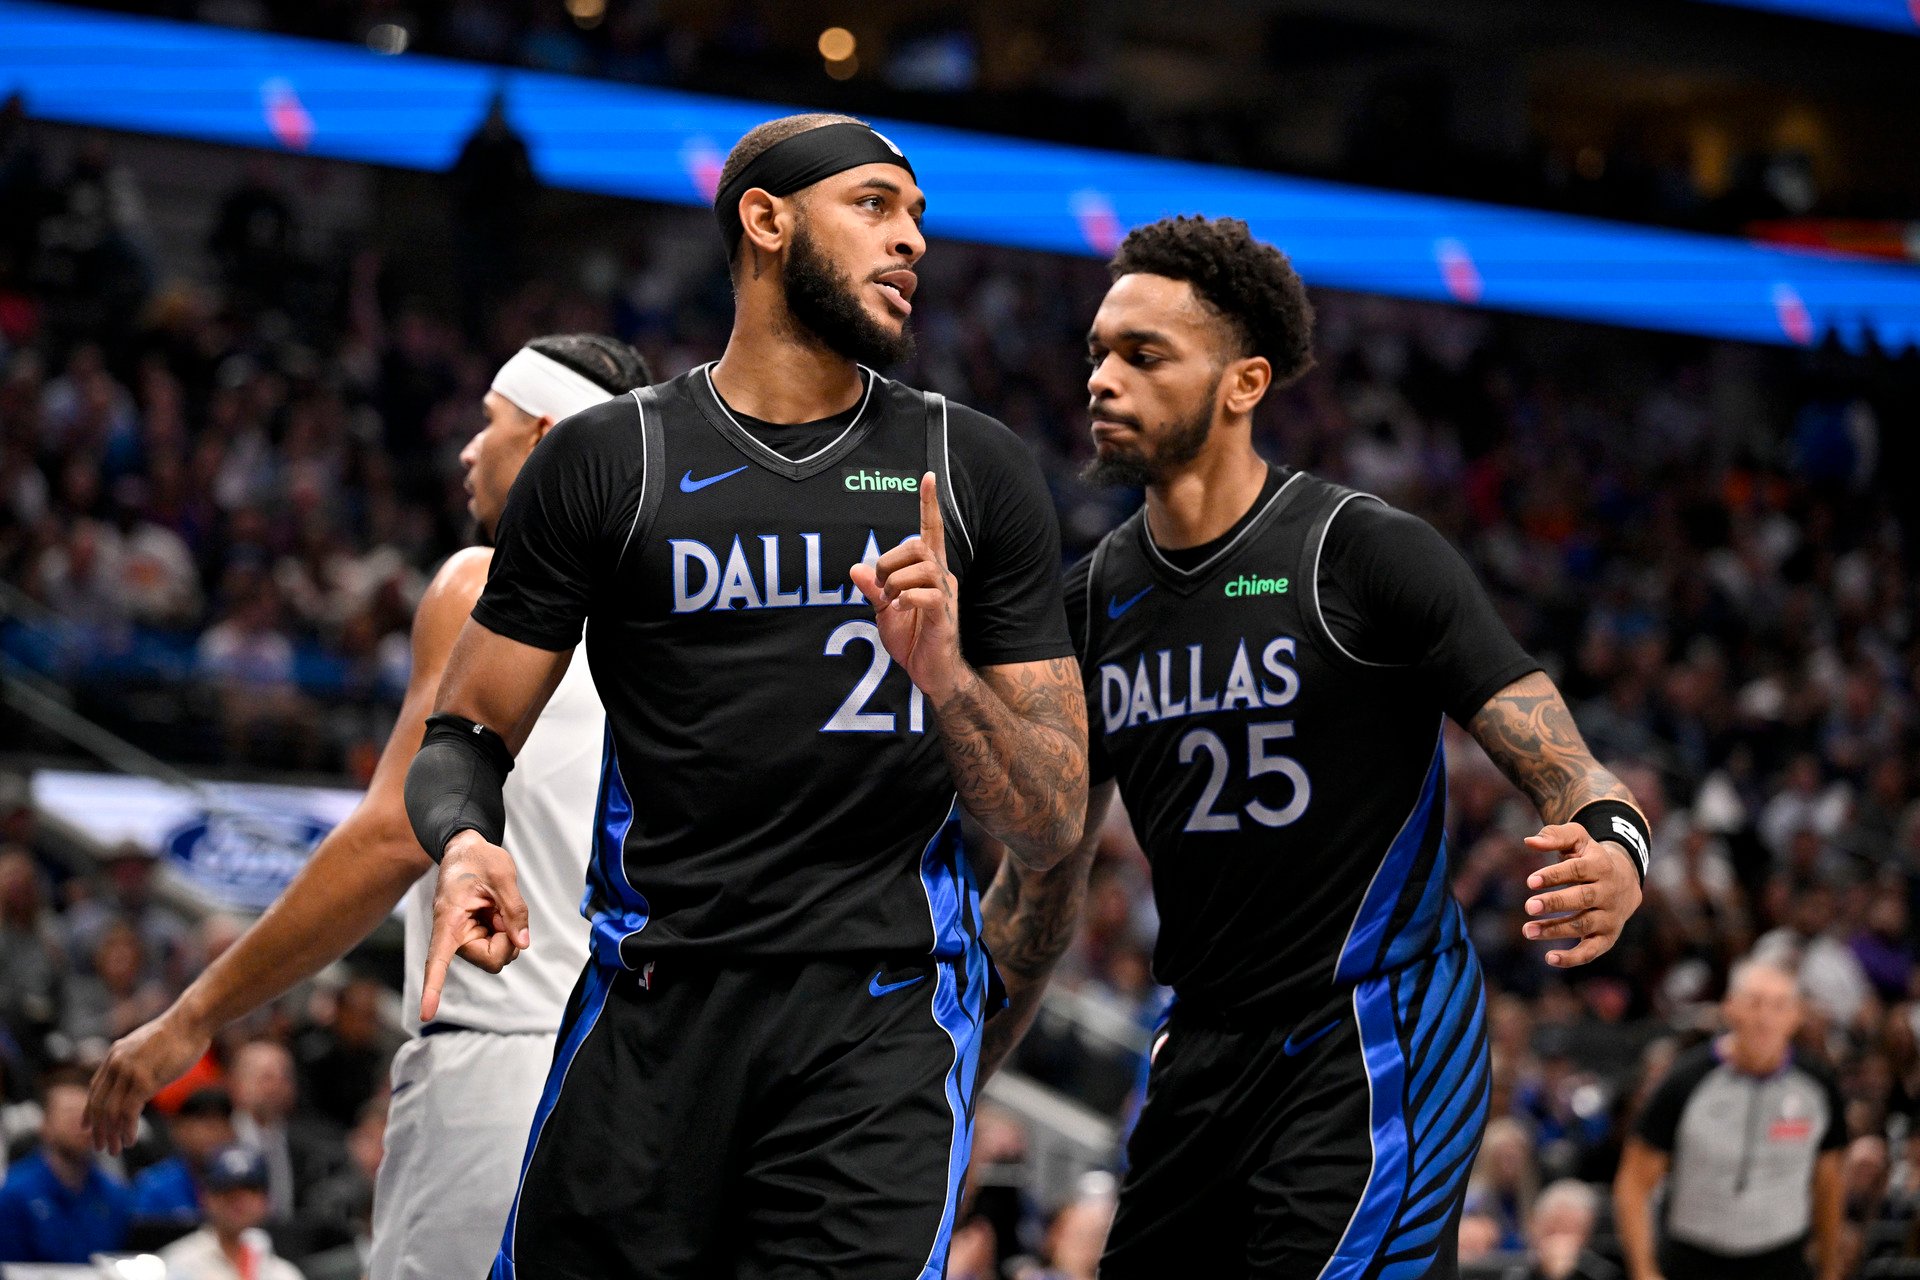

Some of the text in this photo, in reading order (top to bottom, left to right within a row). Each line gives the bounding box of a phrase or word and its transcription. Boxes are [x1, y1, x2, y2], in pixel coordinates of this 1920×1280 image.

[844, 469, 919, 493] chime
[666, 528, 922, 614] DALL
[1224, 573, 1289, 598] chime
[1099, 635, 1301, 735] DALLAS
[1178, 719, 1312, 833] 25
